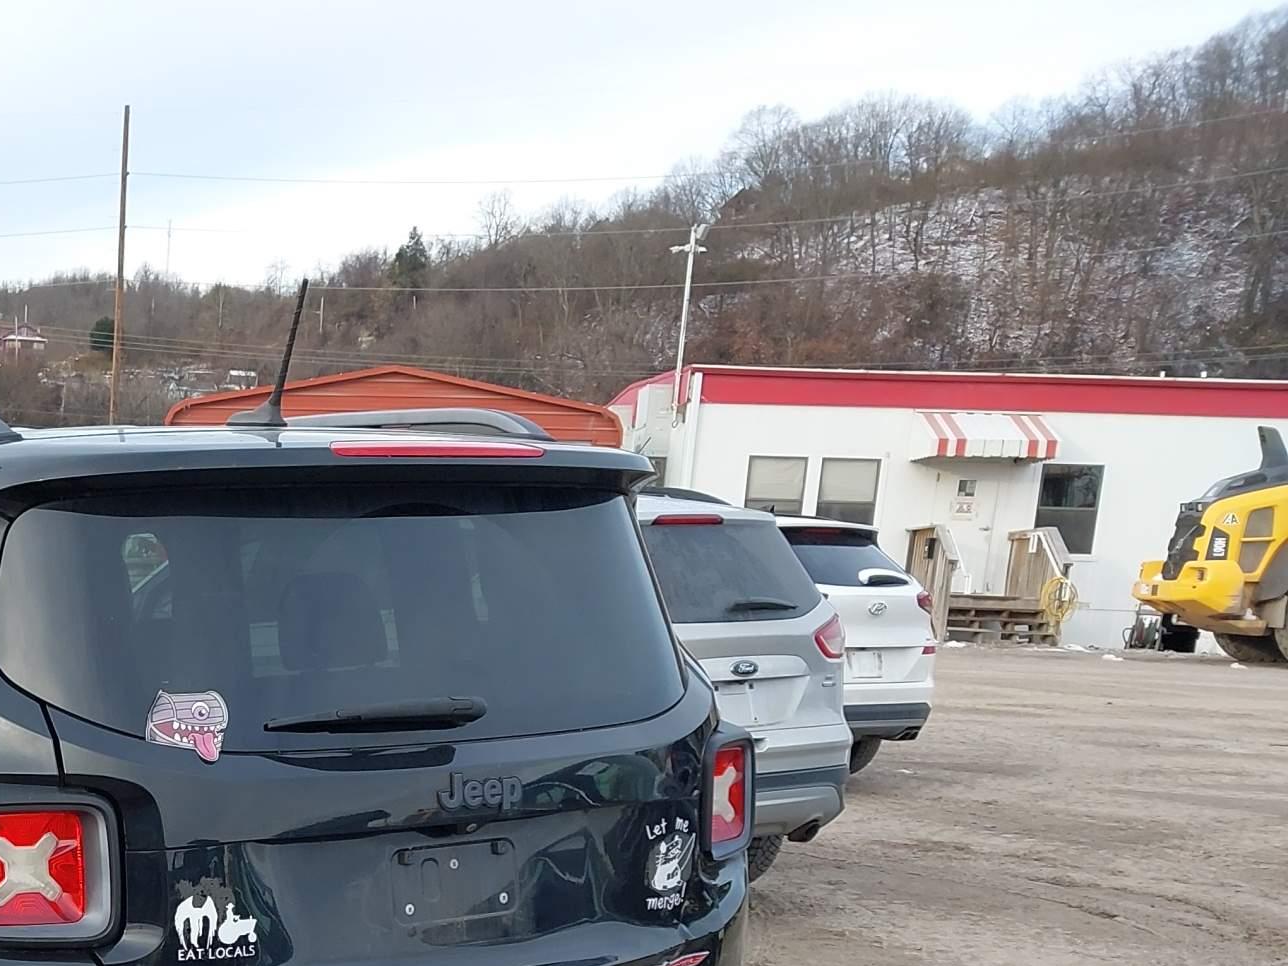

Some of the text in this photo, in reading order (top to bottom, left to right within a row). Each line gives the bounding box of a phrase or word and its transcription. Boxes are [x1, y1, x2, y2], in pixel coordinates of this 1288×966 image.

[437, 773, 521, 811] Jeep
[645, 816, 689, 840] Let me
[645, 881, 687, 910] merge!
[177, 945, 256, 961] EAT LOCALS
